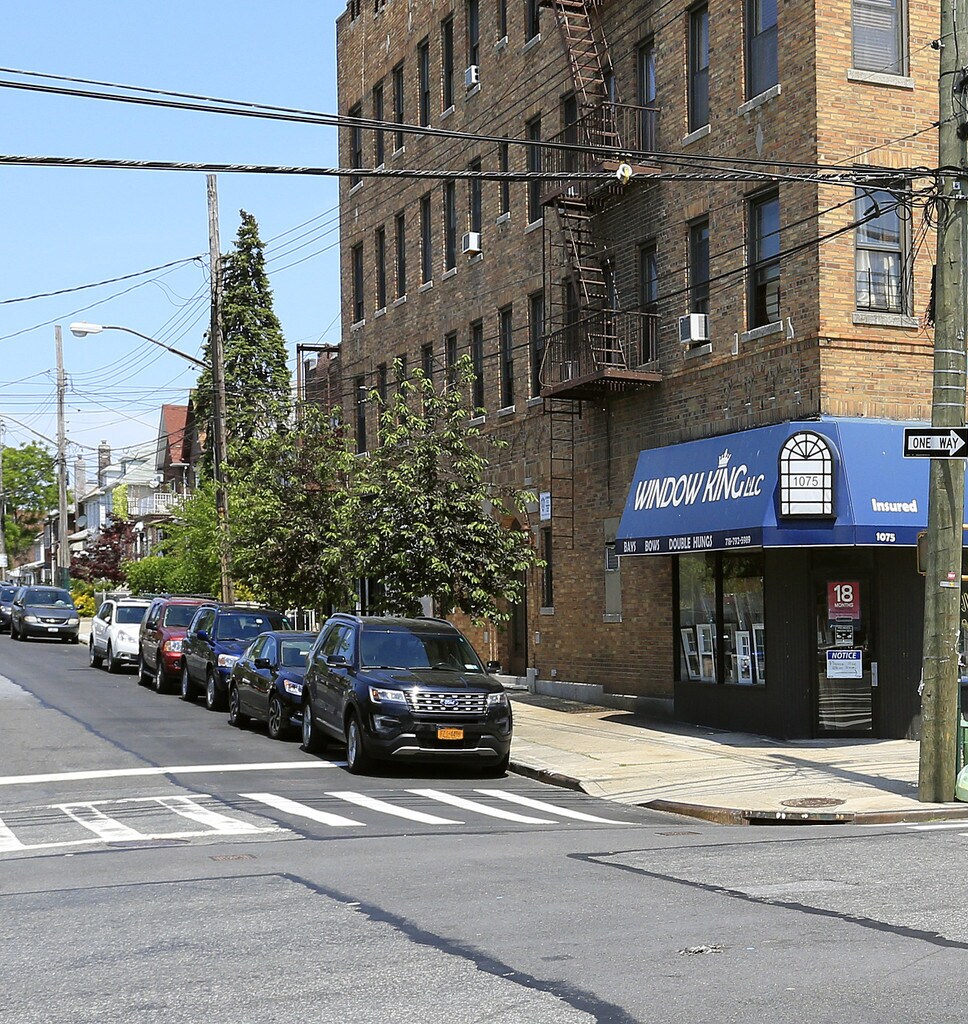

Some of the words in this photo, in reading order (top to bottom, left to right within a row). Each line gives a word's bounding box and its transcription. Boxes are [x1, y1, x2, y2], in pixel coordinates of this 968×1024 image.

[912, 437, 931, 448] ONE
[939, 437, 959, 448] WAY
[633, 472, 706, 511] WINDOW
[702, 464, 747, 503] KING
[743, 474, 765, 497] LLC
[793, 476, 819, 487] 1075
[871, 498, 918, 513] Insured
[875, 532, 896, 542] 1075
[623, 541, 637, 553] BAYS
[644, 539, 660, 552] BOWS
[668, 537, 691, 550] DOUBLE
[692, 535, 713, 549] HUNGS
[833, 584, 853, 602] 18
[831, 652, 857, 660] NOTICE
